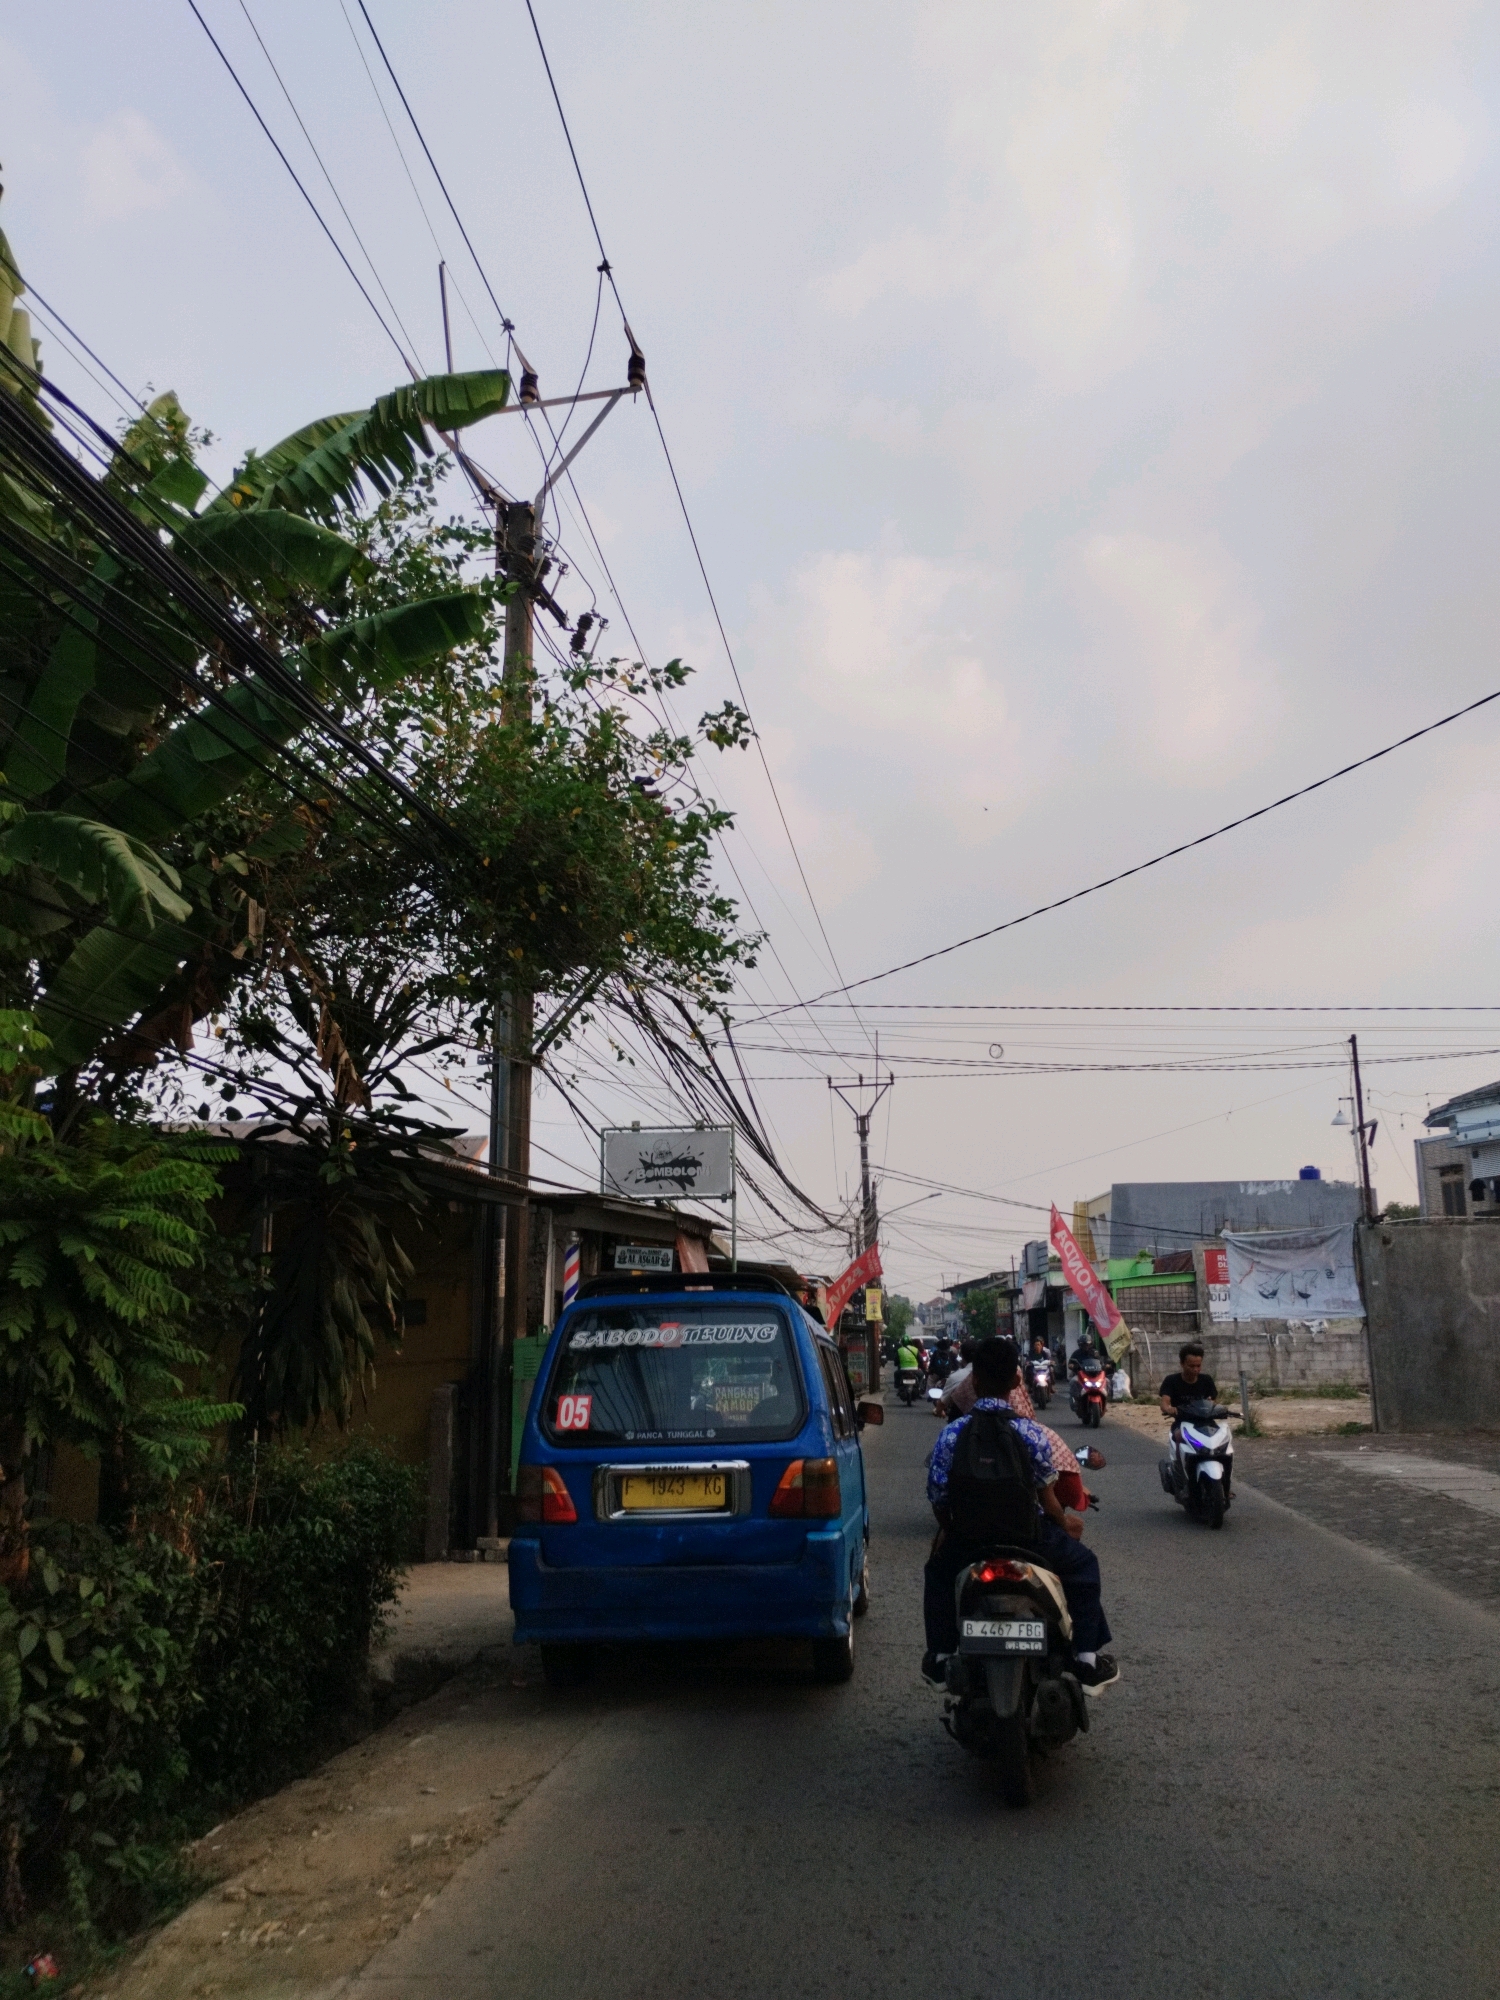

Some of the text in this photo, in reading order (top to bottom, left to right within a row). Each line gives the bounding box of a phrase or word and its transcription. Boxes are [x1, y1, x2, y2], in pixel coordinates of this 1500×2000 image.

[637, 1254, 661, 1265] ASGAR
[569, 1323, 779, 1349] SABODO TEUING
[559, 1396, 590, 1428] 05
[667, 1430, 704, 1439] TUNGGAL
[625, 1476, 722, 1496] F 1943 KG
[966, 1623, 1042, 1637] B 4467 FBG
